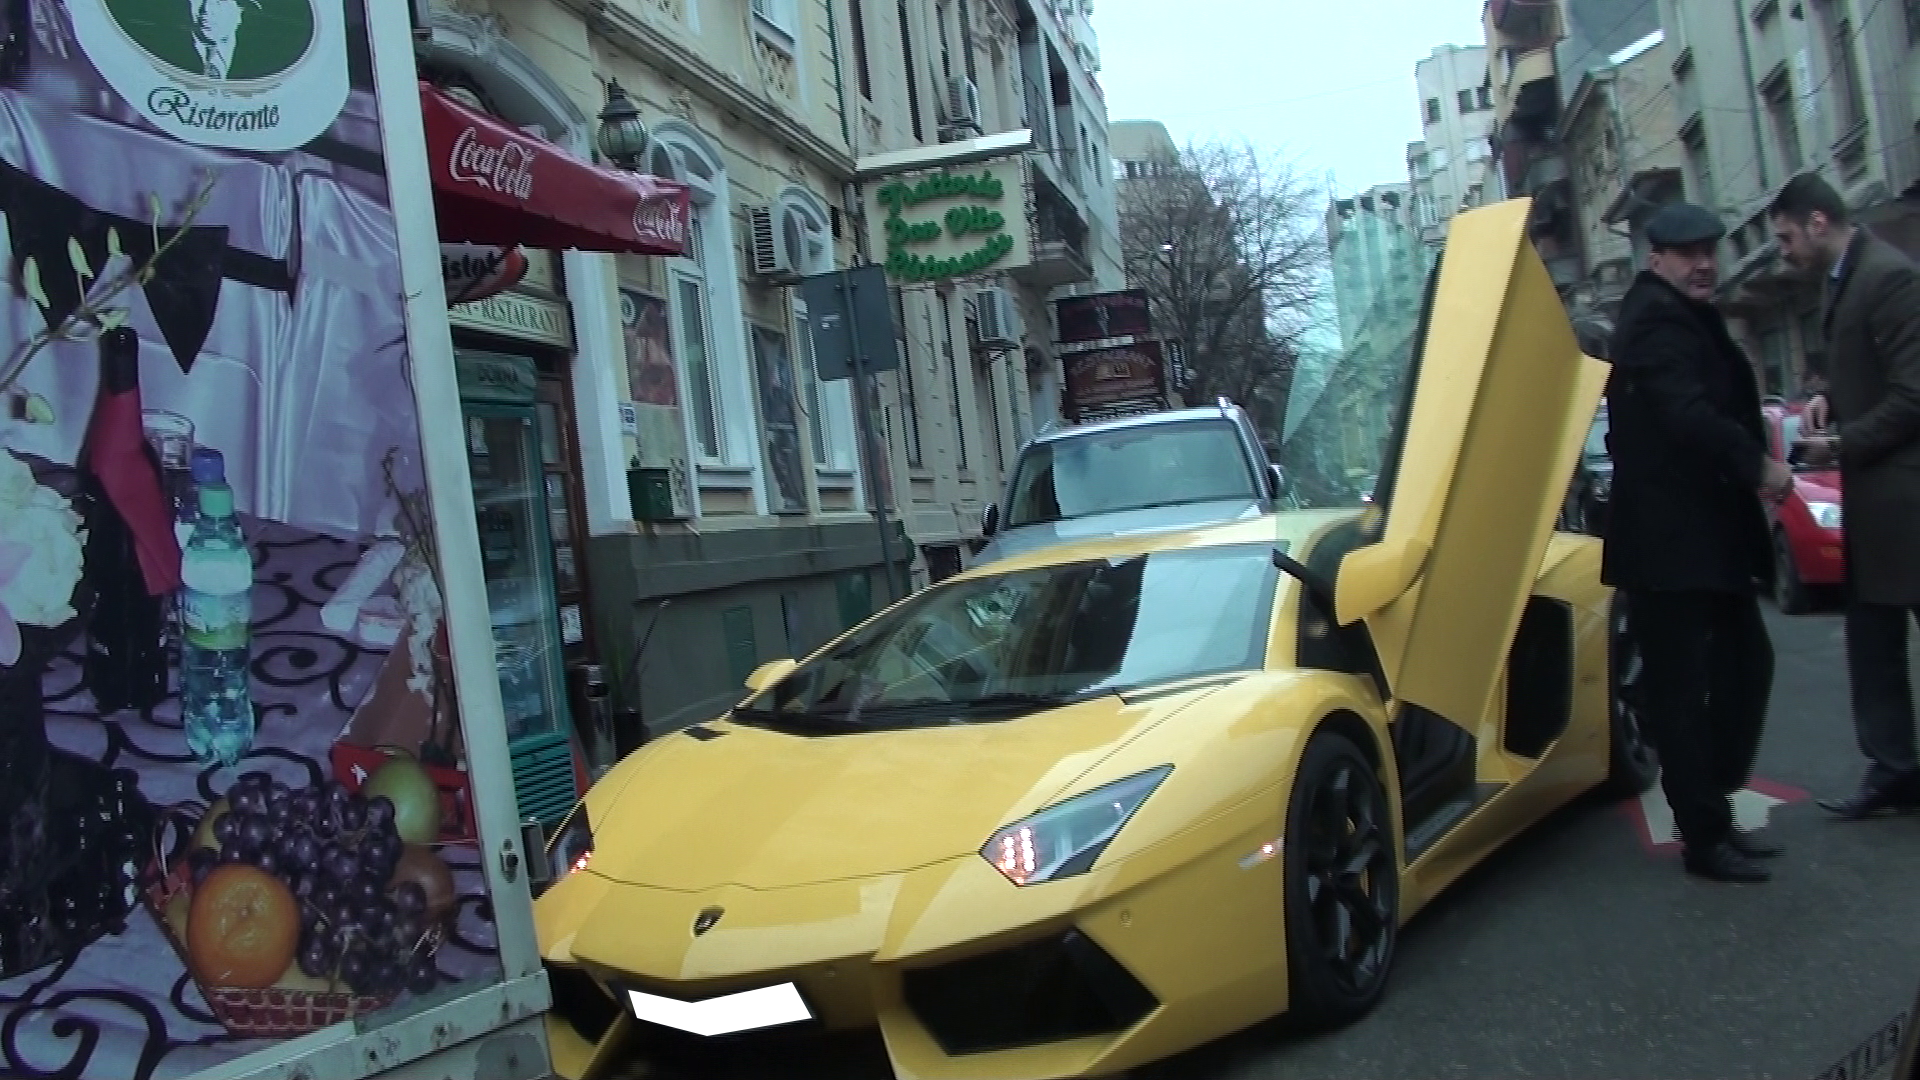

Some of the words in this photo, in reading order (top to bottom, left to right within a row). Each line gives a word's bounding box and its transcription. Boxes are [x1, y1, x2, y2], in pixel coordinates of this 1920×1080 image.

[147, 86, 280, 131] Ristorante
[877, 170, 1004, 217] Trattoria
[884, 217, 942, 248] Don
[884, 233, 1014, 283] Ristorante
